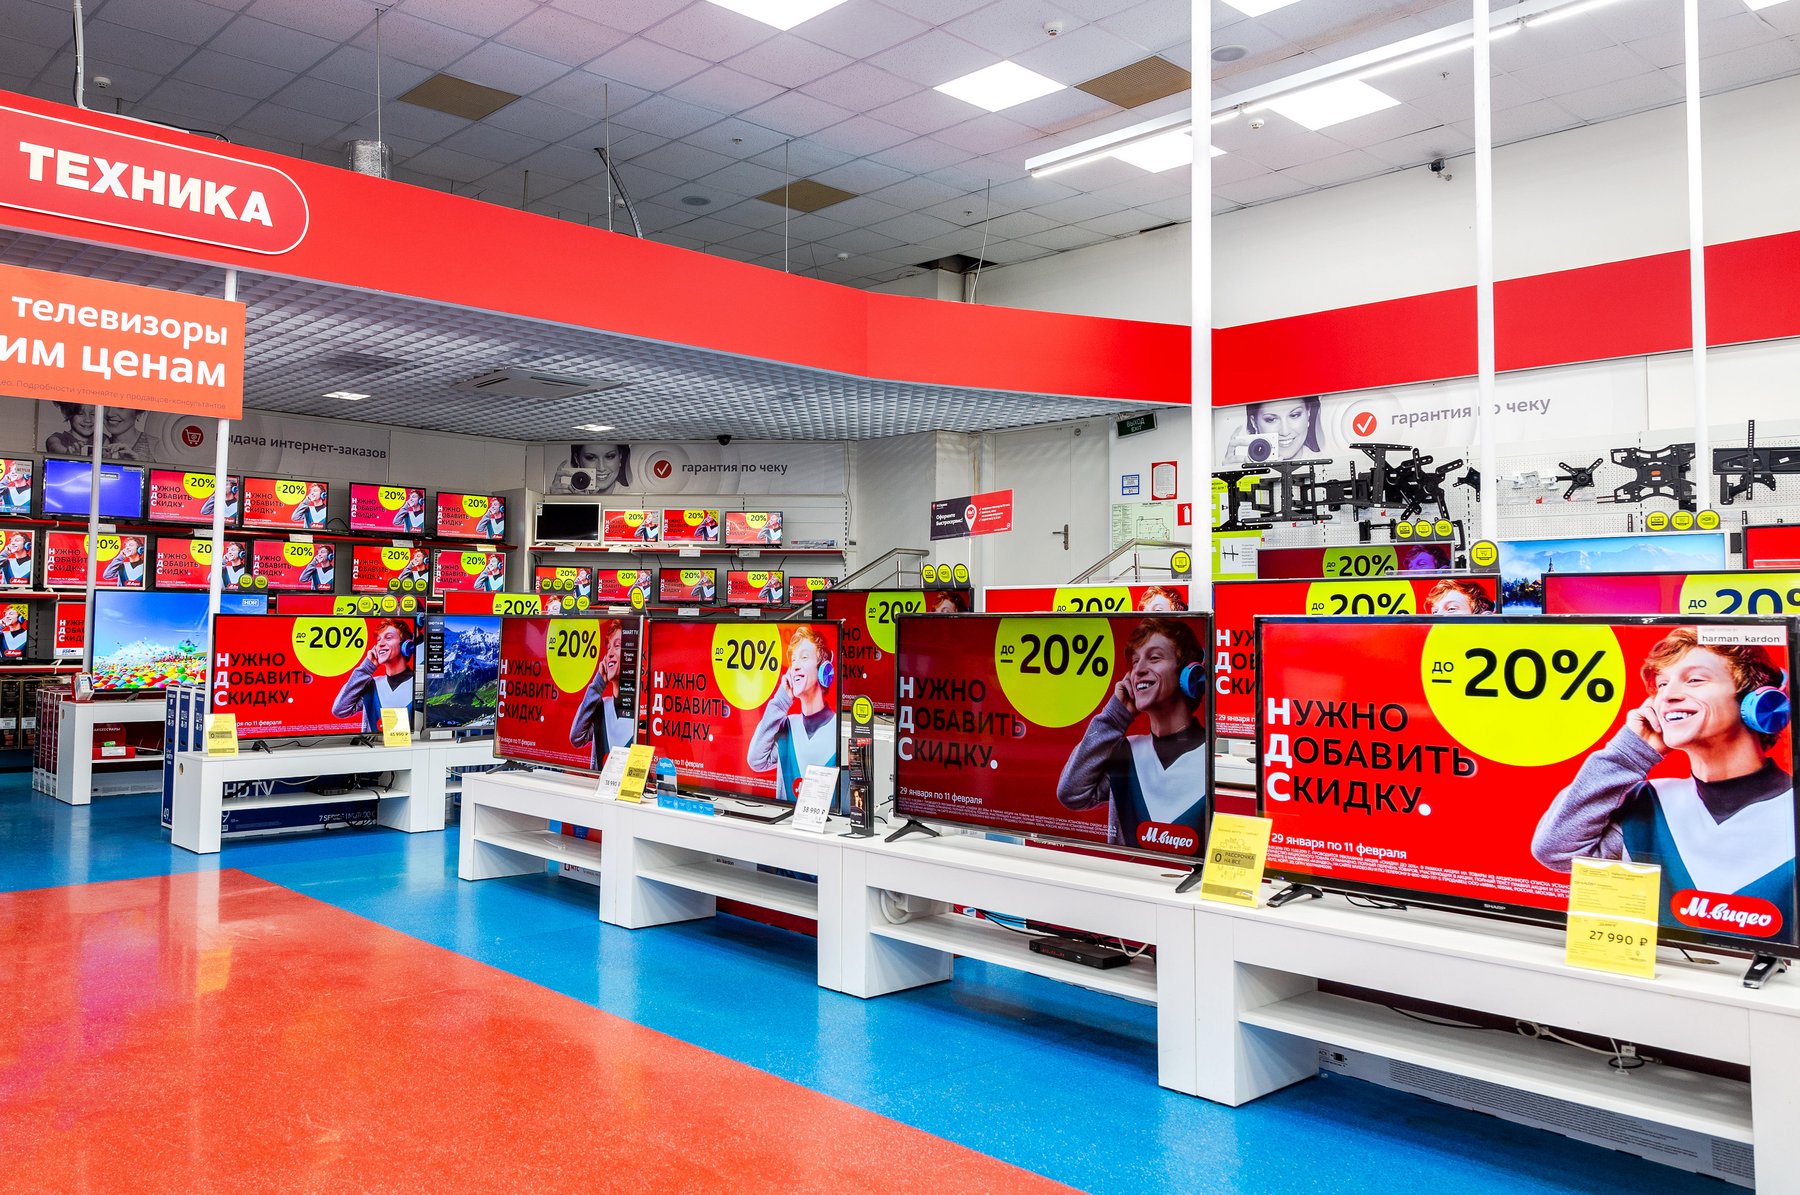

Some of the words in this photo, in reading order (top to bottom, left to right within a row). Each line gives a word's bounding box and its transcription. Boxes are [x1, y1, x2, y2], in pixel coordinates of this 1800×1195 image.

[19, 141, 273, 227] ТЕХНИКА
[12, 295, 228, 349] телевизоры
[82, 345, 226, 388] ценам
[16, 380, 76, 393] Подробности
[77, 387, 118, 399] уточняйте
[1391, 406, 1472, 428] гарантия
[1506, 398, 1551, 415] чеку
[216, 433, 266, 446] дача
[270, 437, 387, 460] интернет-заказов
[682, 461, 738, 476] гарантия
[741, 464, 756, 473] по
[759, 462, 788, 476] чеку
[48, 555, 88, 564] ДОБАВИТ
[216, 652, 286, 667] НУЖНО
[501, 659, 542, 677] НУЖНО
[215, 670, 314, 689] ДОБАВИТЬ
[499, 679, 559, 701] ДОБАВИТЬ
[653, 671, 707, 691] НУЖНО
[899, 676, 986, 704] НУЖНО
[652, 693, 731, 718] ДОБАВИТЬ
[1266, 697, 1408, 732] НУЖНО
[898, 706, 1026, 738] ДОБАВИТЬ
[1264, 734, 1479, 778] ДОБАВИТЬ
[252, 780, 276, 798] TV
[900, 786, 908, 795] 29
[908, 789, 932, 799] января
[934, 792, 944, 800] по
[944, 792, 950, 800] 11
[952, 792, 983, 805] февраля
[810, 806, 820, 814] 990
[1141, 827, 1194, 849] М.видео
[1272, 833, 1284, 844] 29
[1286, 834, 1325, 850] января
[1327, 840, 1342, 851] по
[1344, 842, 1354, 852] 11
[1356, 842, 1407, 860] февраля
[1225, 852, 1254, 860] РАССРОЧКА
[1680, 896, 1772, 929] М.видео
[1589, 930, 1604, 940] 27
[1608, 932, 1634, 946] 990
